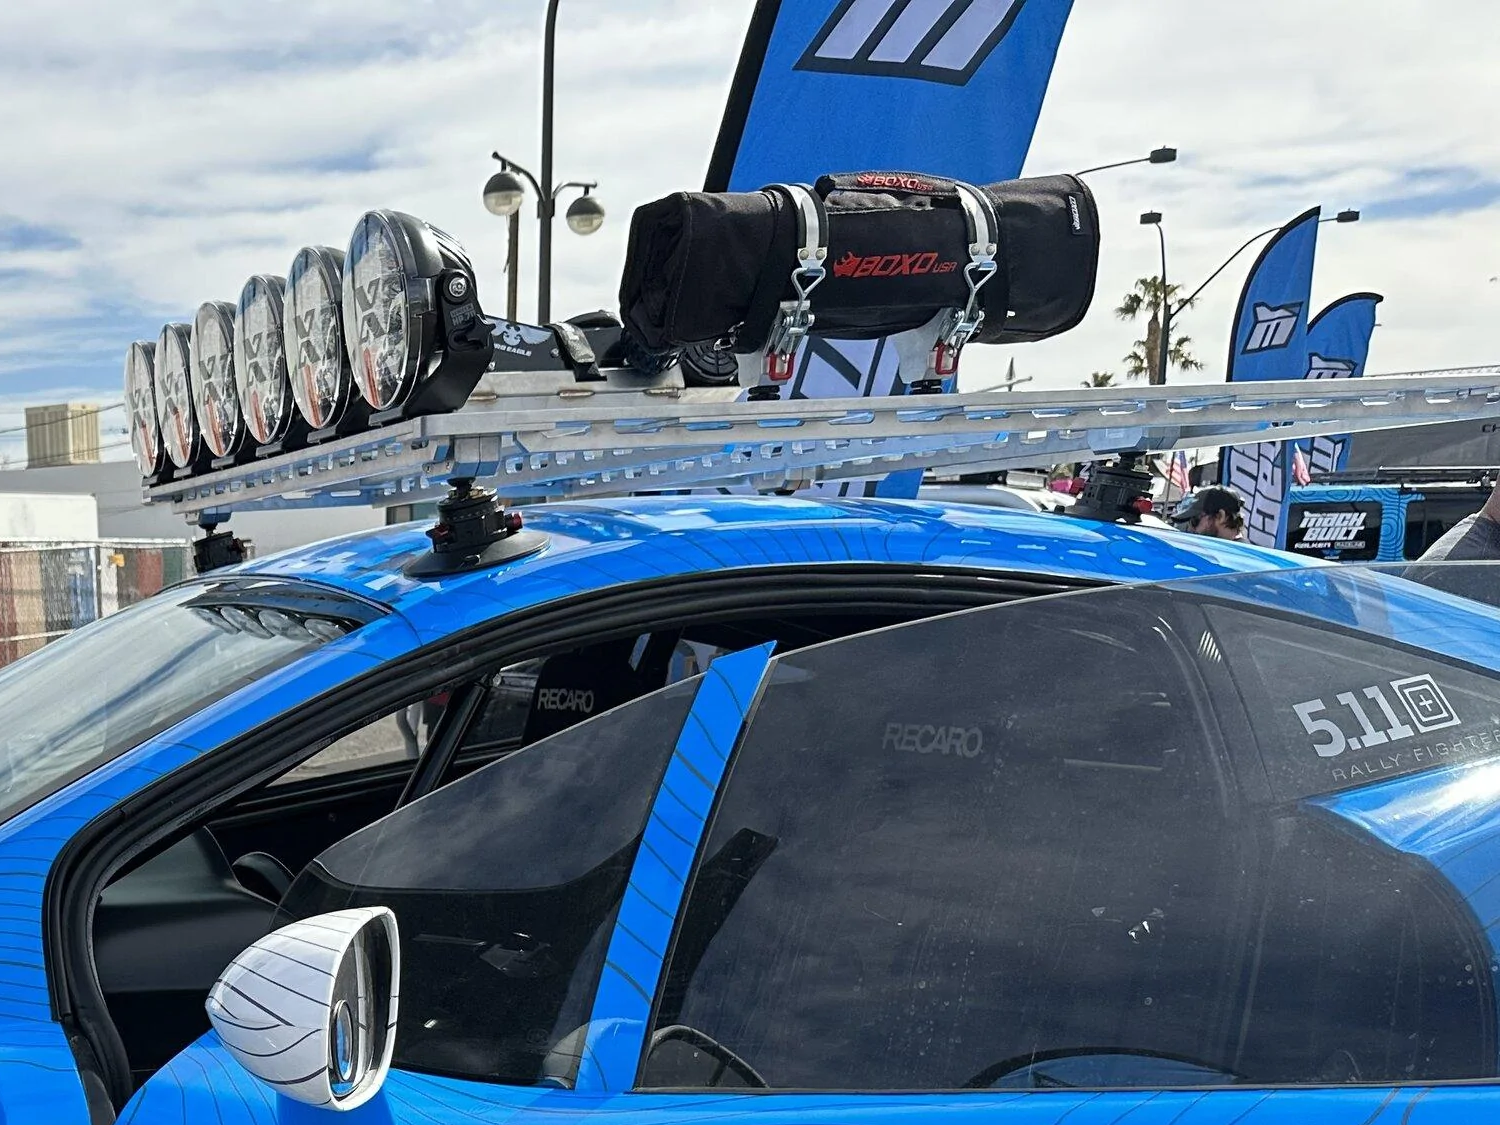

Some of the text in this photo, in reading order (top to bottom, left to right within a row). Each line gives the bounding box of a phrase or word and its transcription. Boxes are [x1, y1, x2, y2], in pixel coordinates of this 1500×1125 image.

[873, 175, 918, 190] BOXO
[854, 252, 957, 278] BOXO USA
[1303, 526, 1365, 541] BUILT
[537, 688, 595, 713] RECARO
[1292, 685, 1415, 758] 5.11
[882, 722, 984, 758] RECARO
[1332, 753, 1402, 782] RALLY
